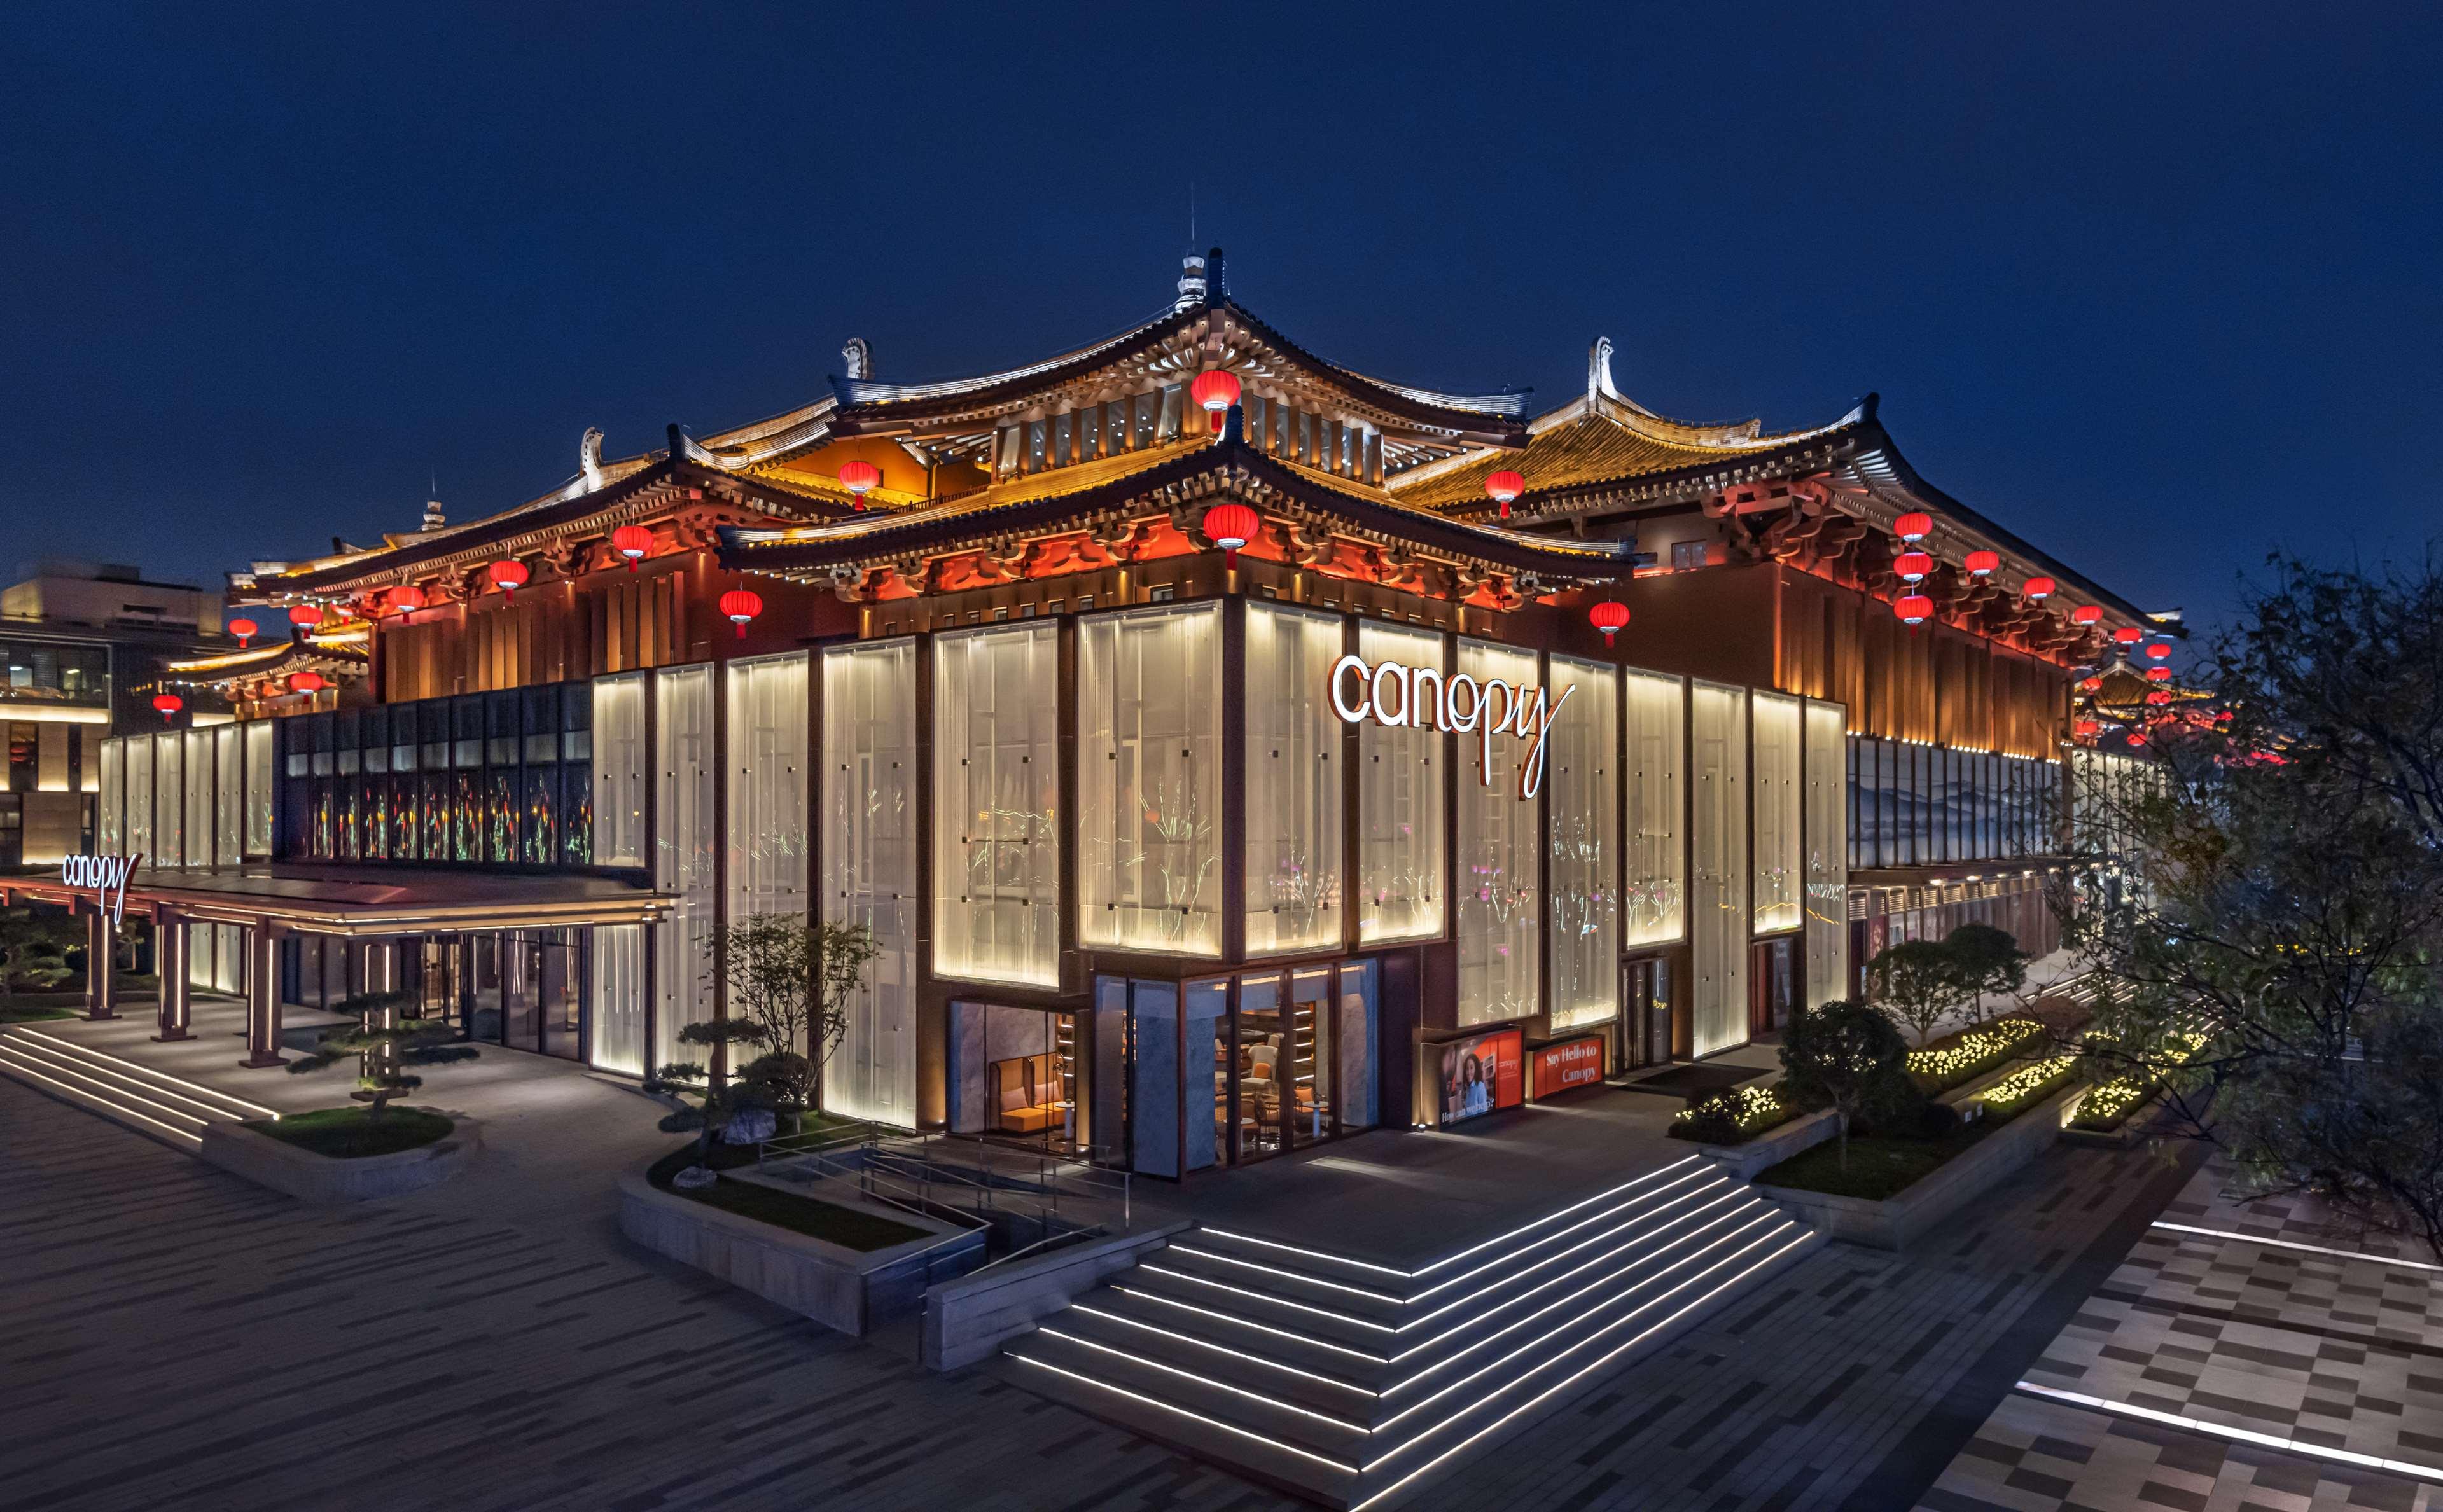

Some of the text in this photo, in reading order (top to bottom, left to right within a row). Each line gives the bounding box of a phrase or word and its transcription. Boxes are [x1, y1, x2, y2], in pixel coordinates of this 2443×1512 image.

[1328, 655, 1576, 800] canopy
[63, 854, 139, 925] canopy
[1547, 1045, 1597, 1067] Say Hello to
[1563, 1067, 1597, 1083] Canopy
